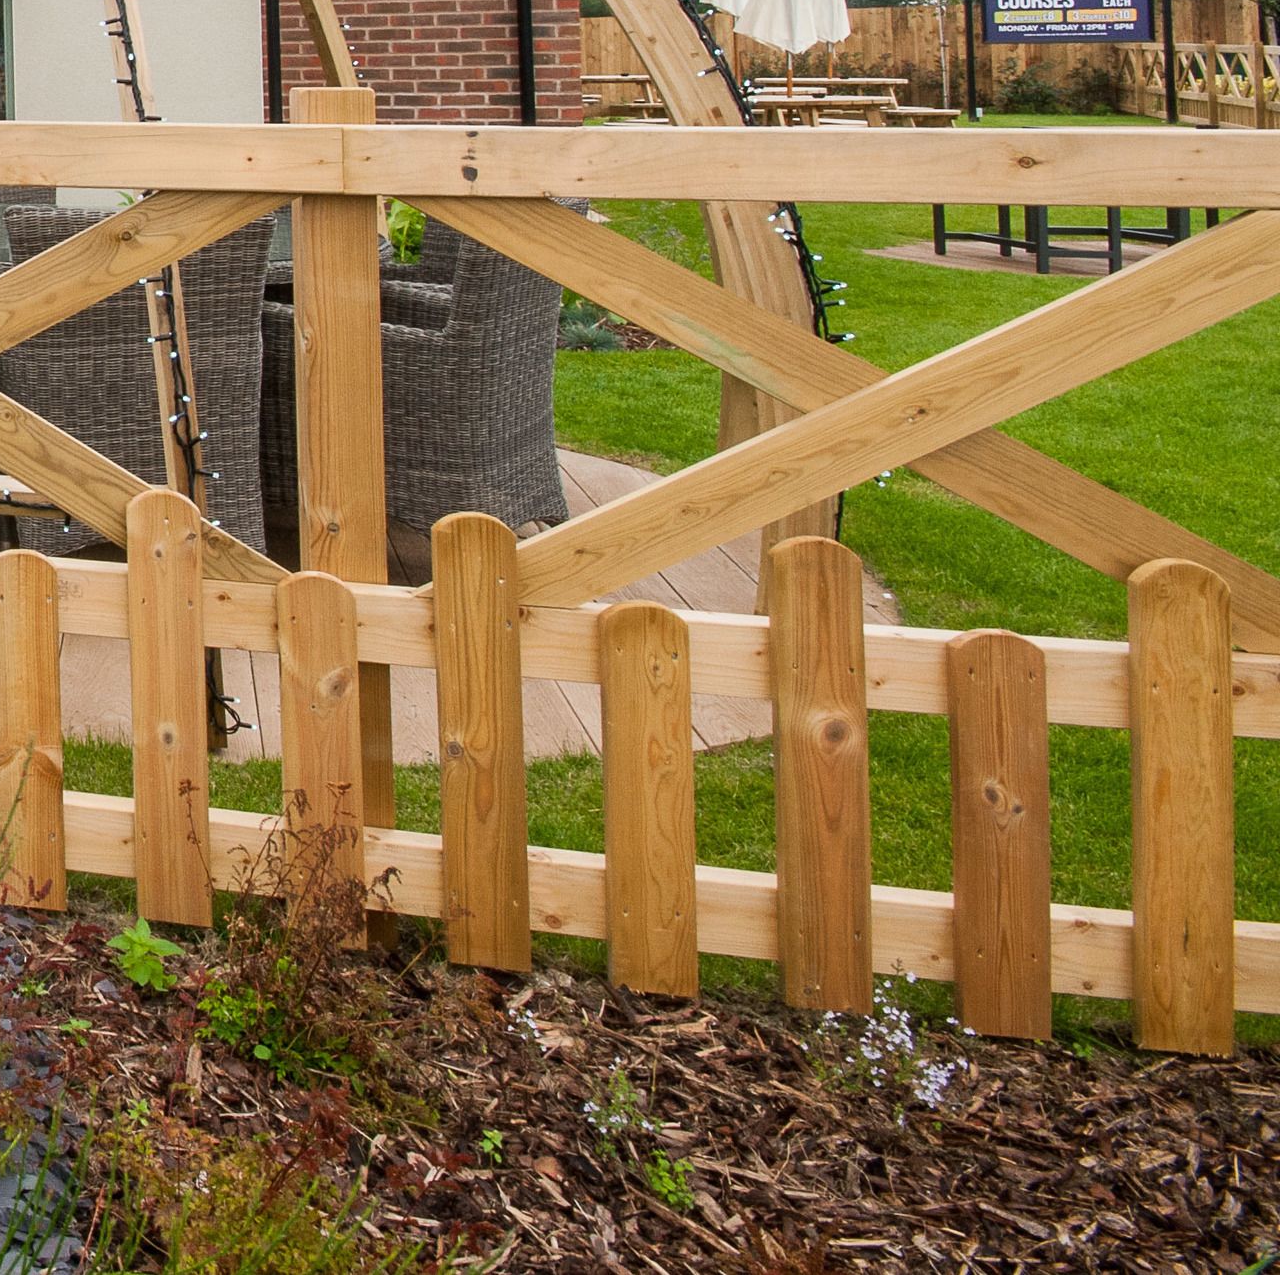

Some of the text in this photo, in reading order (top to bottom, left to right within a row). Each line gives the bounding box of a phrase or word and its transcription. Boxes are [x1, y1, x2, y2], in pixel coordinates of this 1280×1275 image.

[998, 24, 1039, 32] MONDAY
[1046, 24, 1079, 32] FRIDAY
[1082, 23, 1106, 31] 12PM
